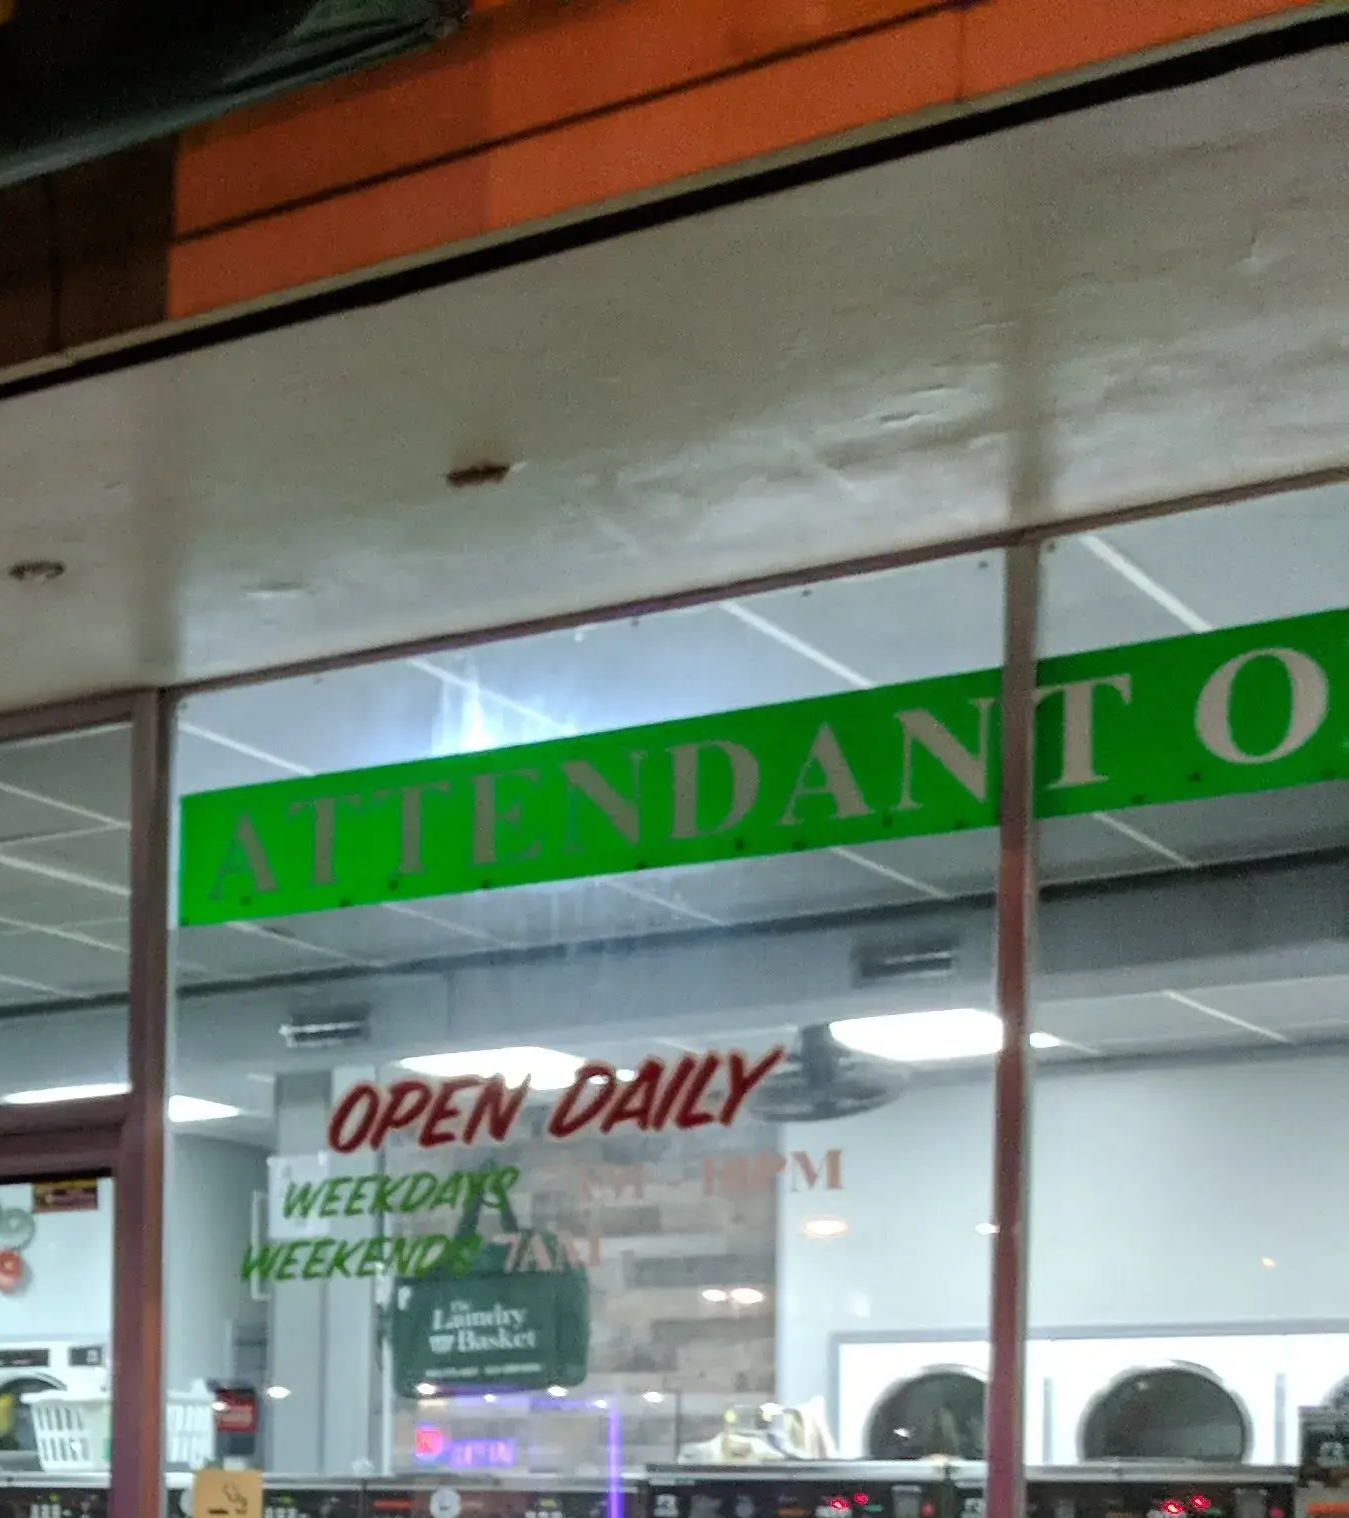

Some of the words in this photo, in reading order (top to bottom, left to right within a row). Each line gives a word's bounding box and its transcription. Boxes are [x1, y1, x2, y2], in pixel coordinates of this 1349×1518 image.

[209, 672, 1132, 900] ATTENDANT
[1194, 645, 1349, 765] O
[327, 1074, 532, 1155] OPEN
[547, 1044, 788, 1139] DAILY
[281, 1164, 521, 1219] WEEKDAYS
[241, 1232, 485, 1283] WEEKENDS
